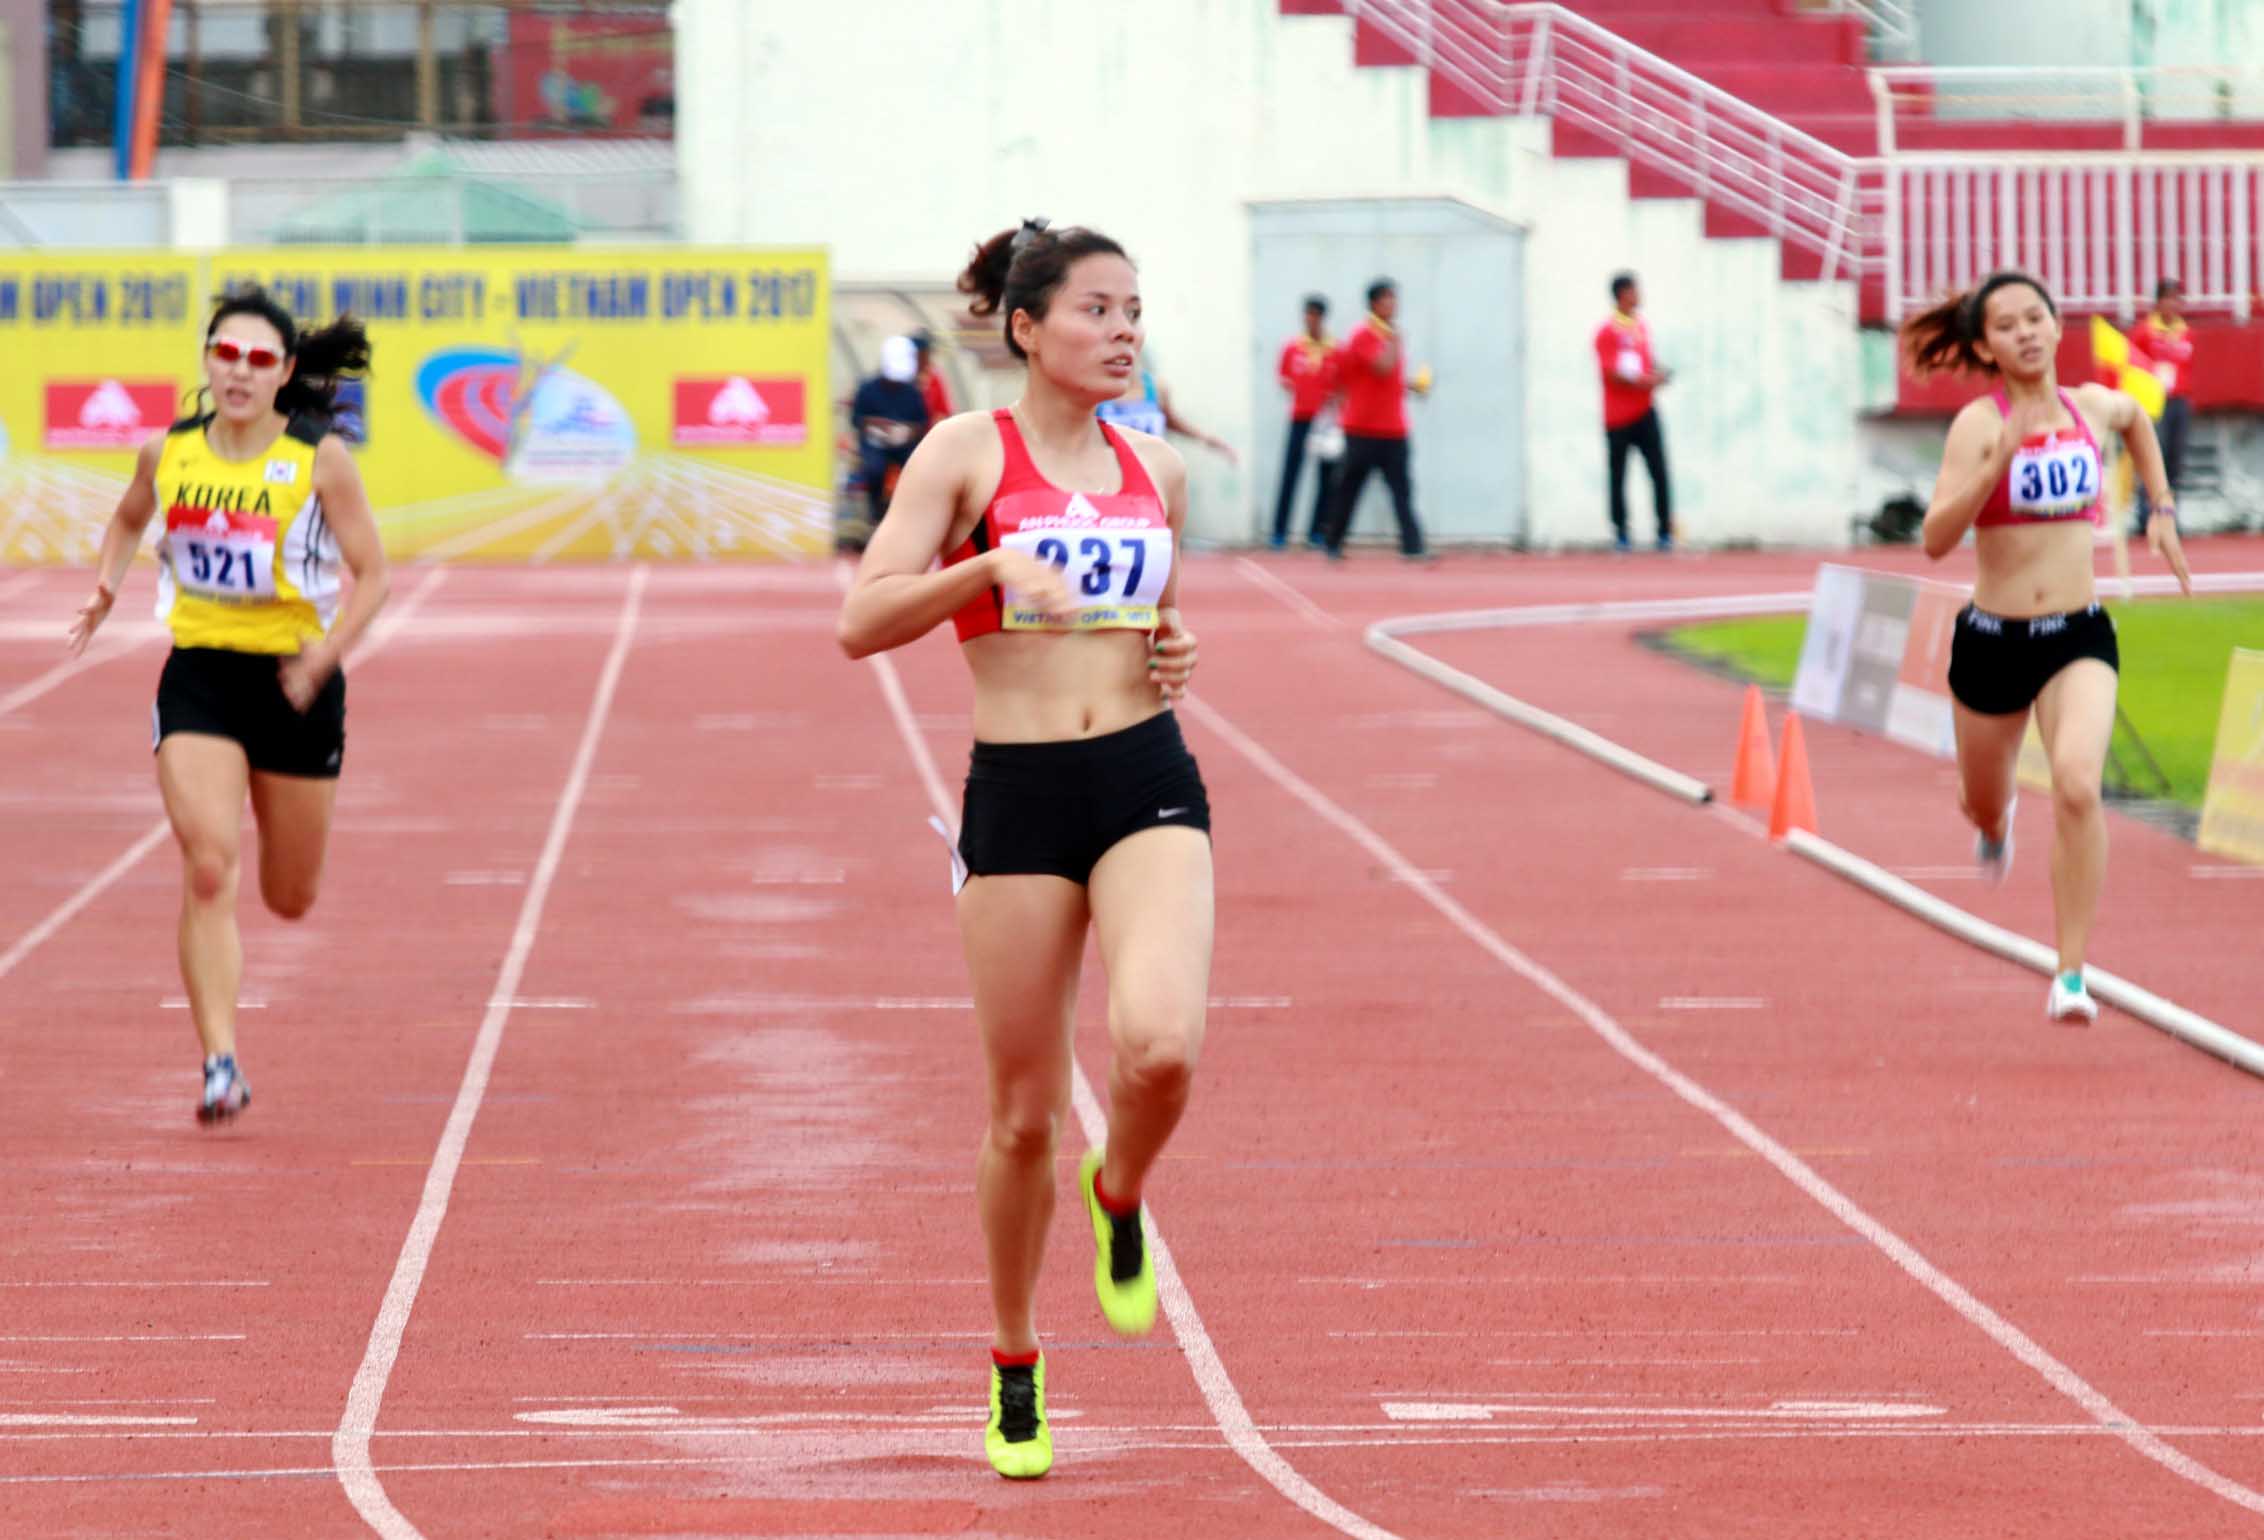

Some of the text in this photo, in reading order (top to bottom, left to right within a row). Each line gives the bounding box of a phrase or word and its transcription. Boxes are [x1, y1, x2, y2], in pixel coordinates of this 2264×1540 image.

[33, 272, 110, 323] OPEN
[121, 272, 187, 323] 2017
[421, 271, 484, 320] CITY
[515, 271, 649, 319] VIETNAM
[662, 271, 735, 319] OPEN
[749, 271, 816, 319] 2017
[175, 482, 270, 515] KOREA
[2022, 456, 2090, 501] 302
[188, 542, 255, 589] 521
